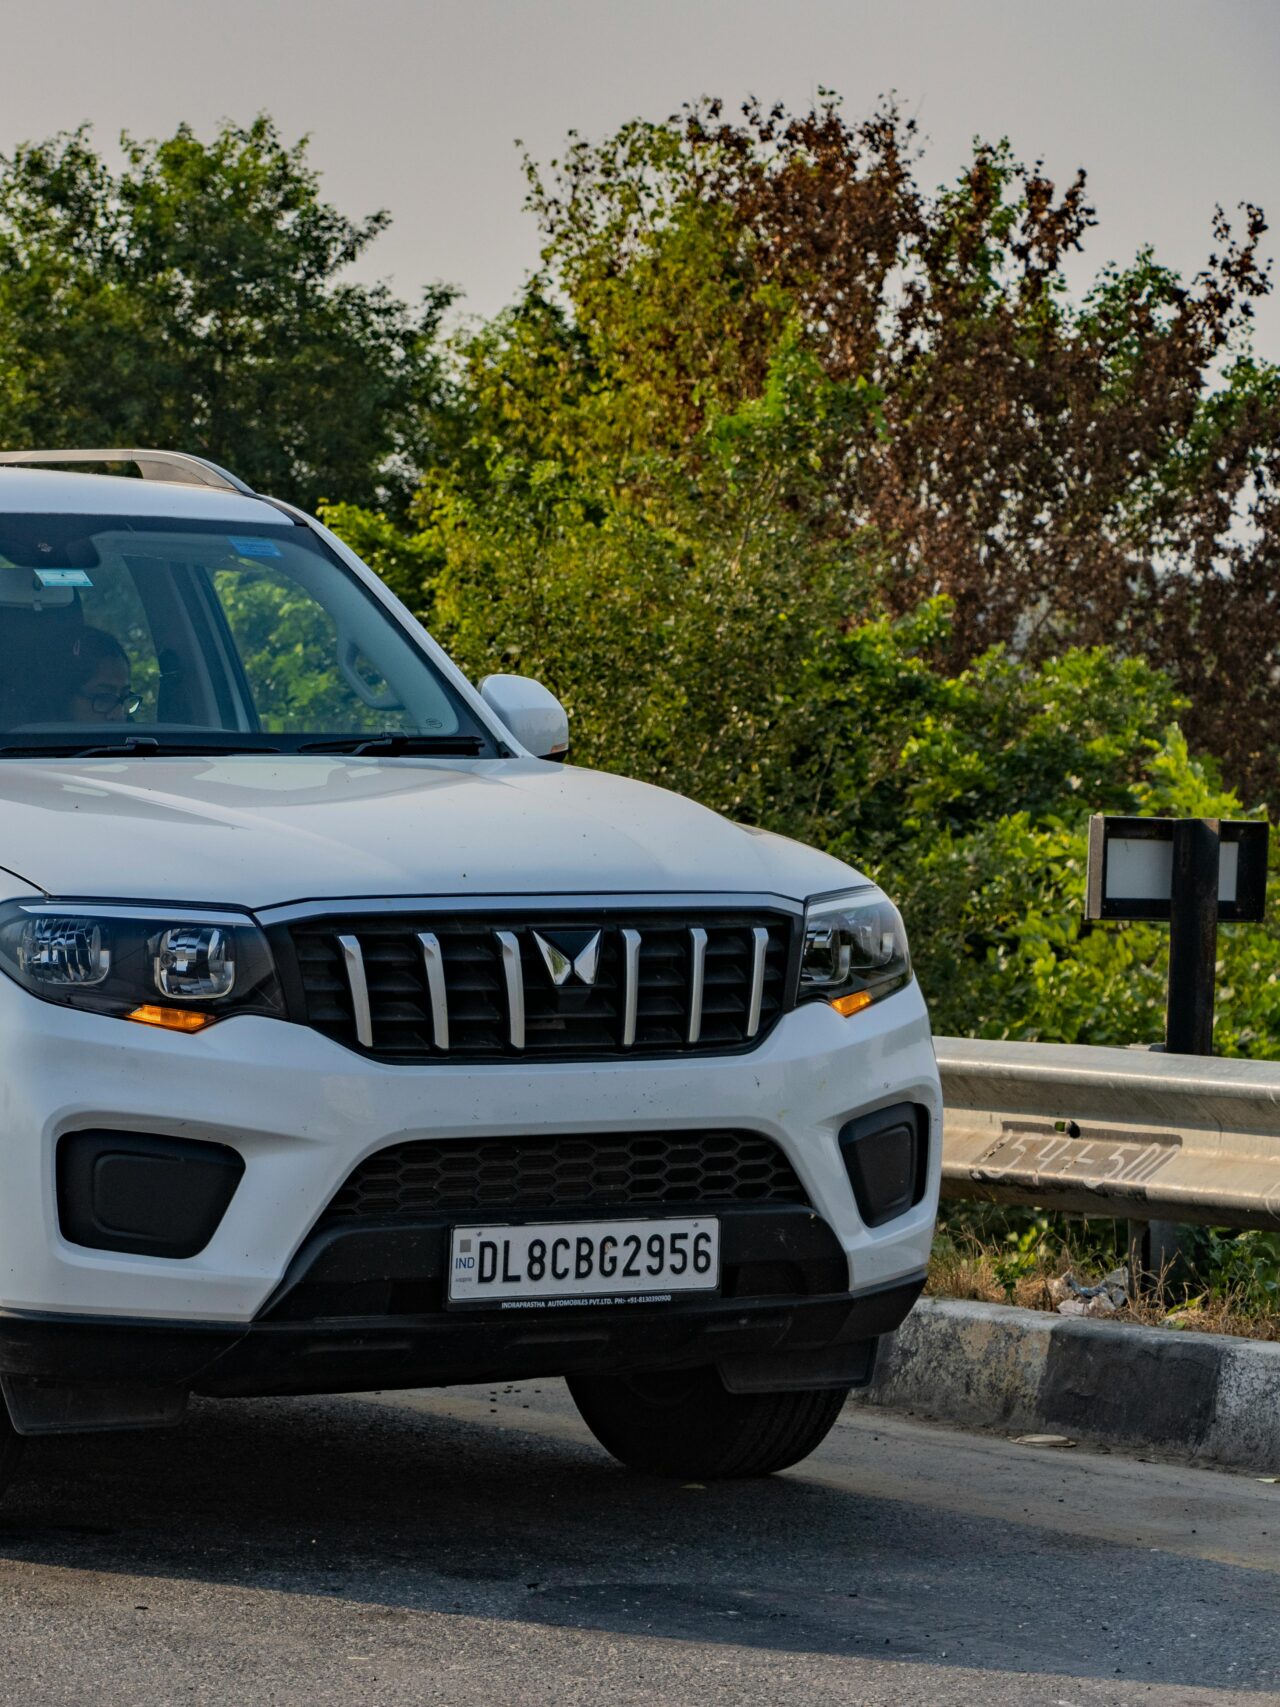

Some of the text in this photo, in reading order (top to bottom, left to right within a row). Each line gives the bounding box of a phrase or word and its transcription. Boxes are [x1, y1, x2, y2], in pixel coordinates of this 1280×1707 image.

[455, 1256, 475, 1269] IND
[477, 1231, 712, 1284] DL8CBG2956
[547, 1299, 588, 1308] AUTOMOBILES
